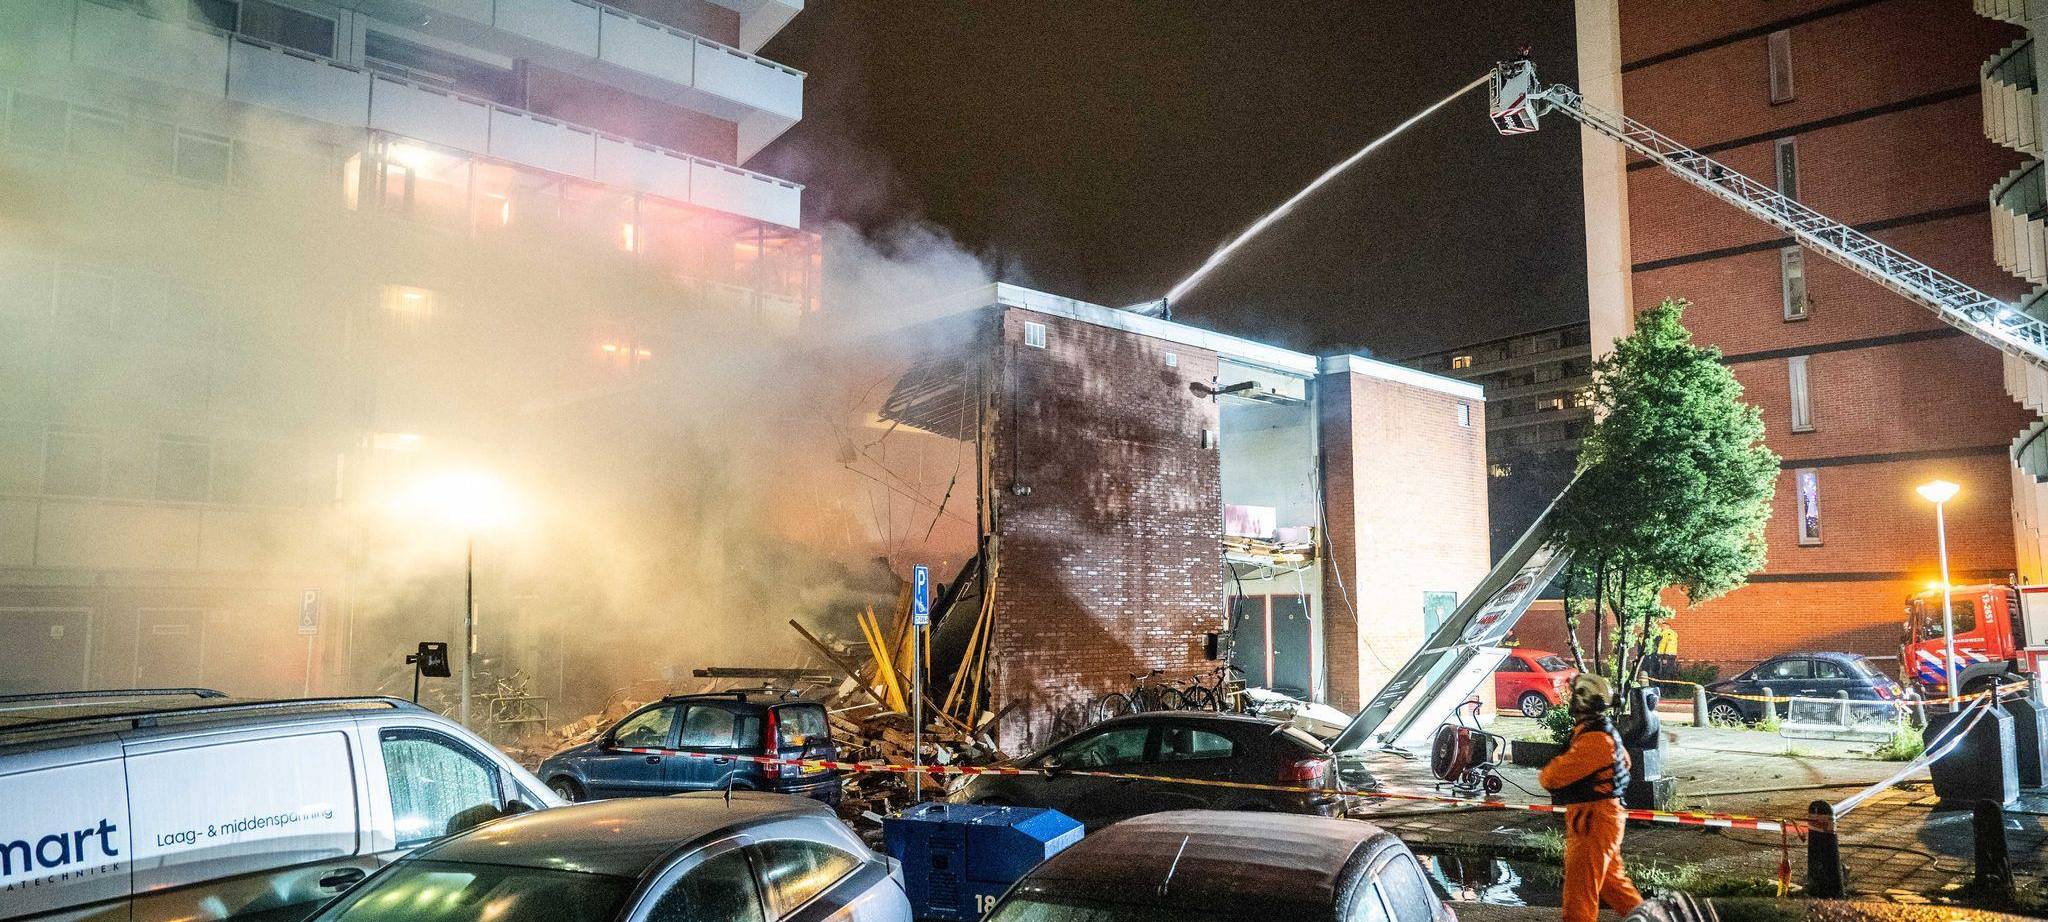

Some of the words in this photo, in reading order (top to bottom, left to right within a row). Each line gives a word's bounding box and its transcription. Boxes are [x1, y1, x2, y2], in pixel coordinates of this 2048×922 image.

[918, 570, 926, 595] P
[0, 818, 119, 876] mart
[157, 830, 203, 847] Laag-
[207, 824, 217, 838] &
